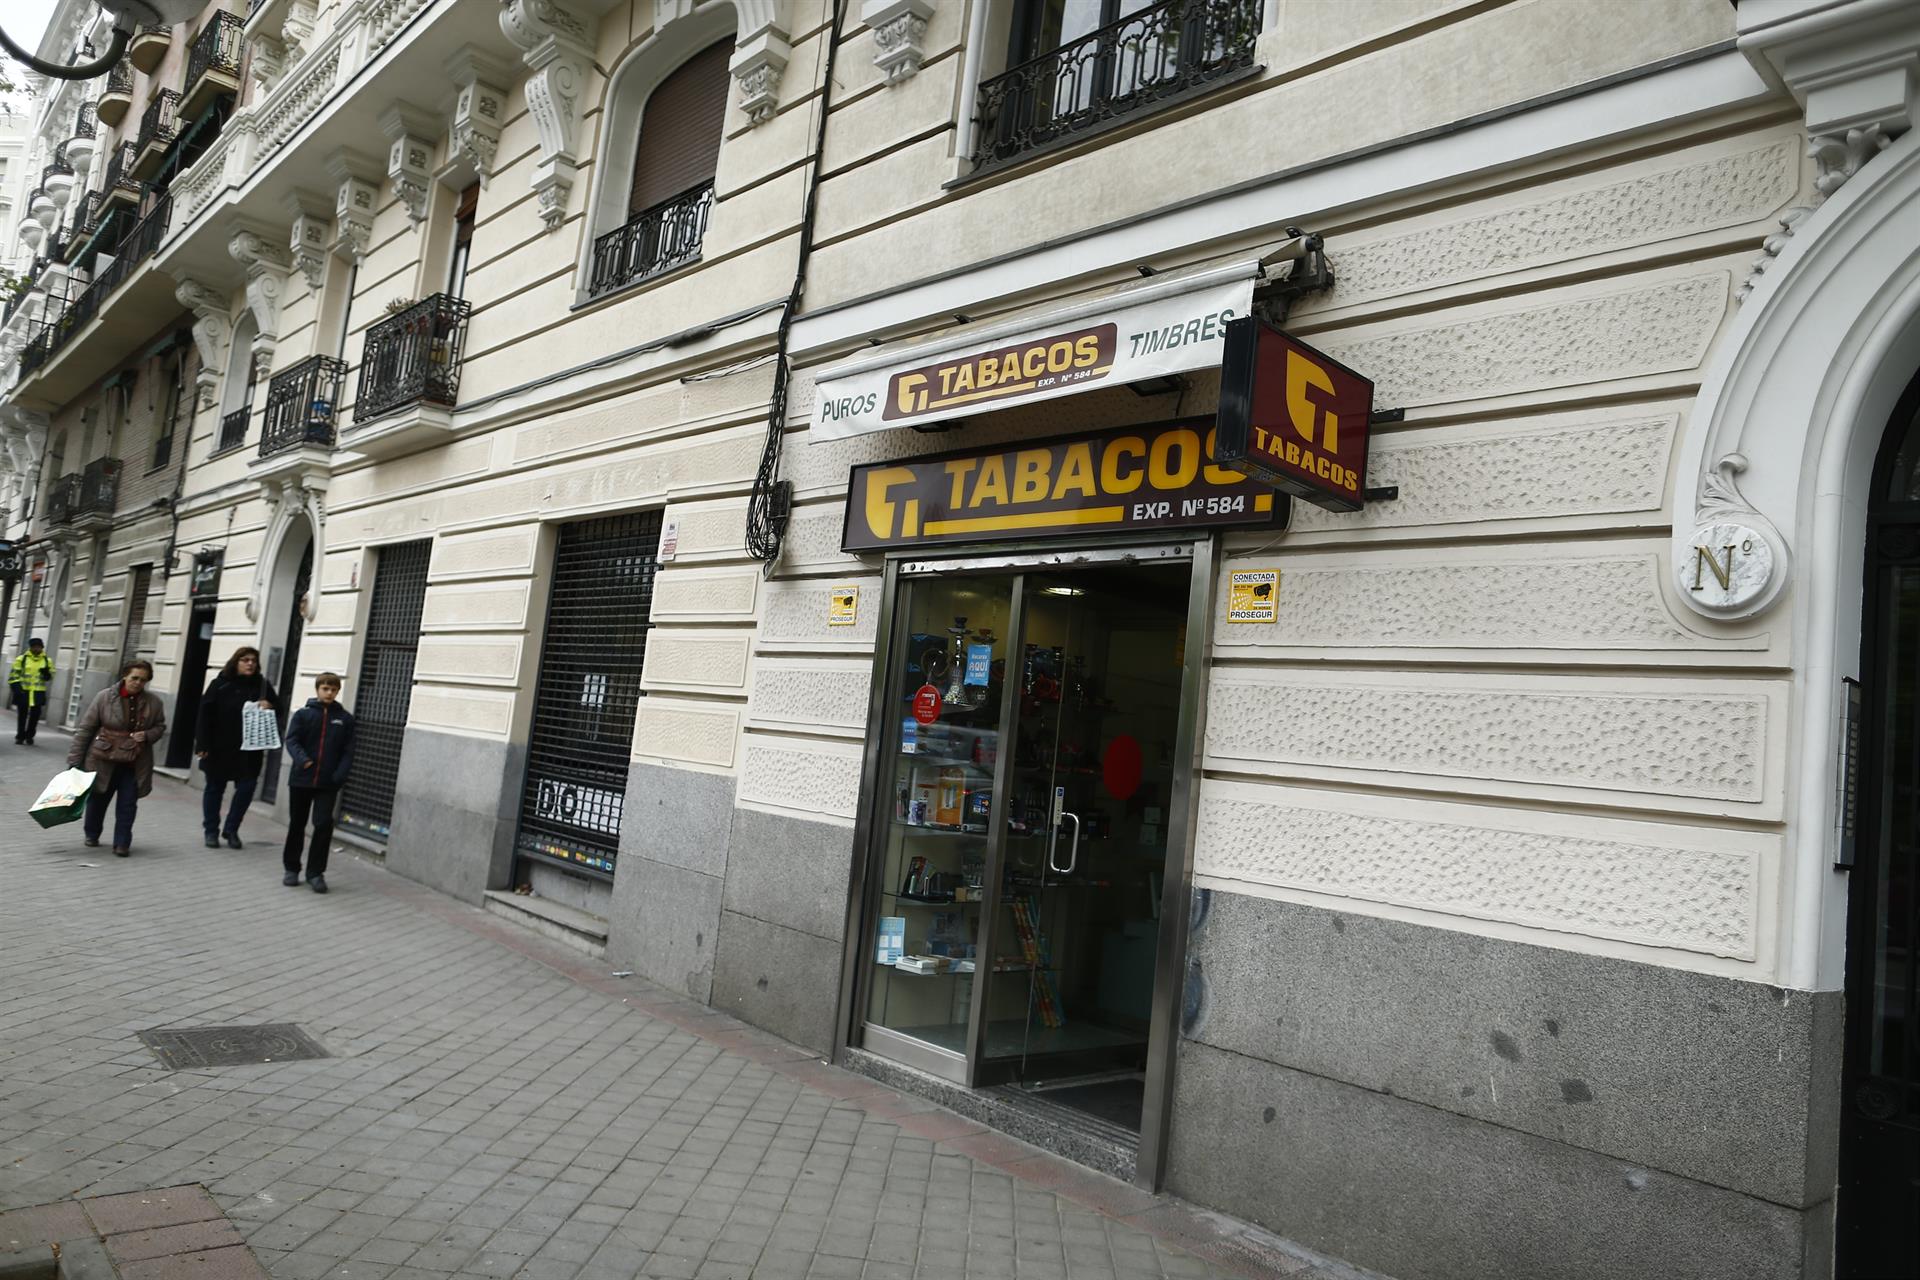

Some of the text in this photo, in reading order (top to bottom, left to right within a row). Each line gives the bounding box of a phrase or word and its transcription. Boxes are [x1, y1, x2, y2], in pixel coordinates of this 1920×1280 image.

[1130, 309, 1234, 358] TIMBRES
[938, 335, 1099, 396] TABACOS
[1037, 377, 1056, 387] EXP.
[1074, 370, 1092, 381] 584
[821, 393, 877, 423] PUROS
[1255, 426, 1358, 492] TABACOS
[1132, 501, 1174, 521] EXP.
[1206, 495, 1245, 515] 584
[1233, 573, 1275, 581] CONECTADA
[1230, 611, 1273, 619] PROSEGUR
